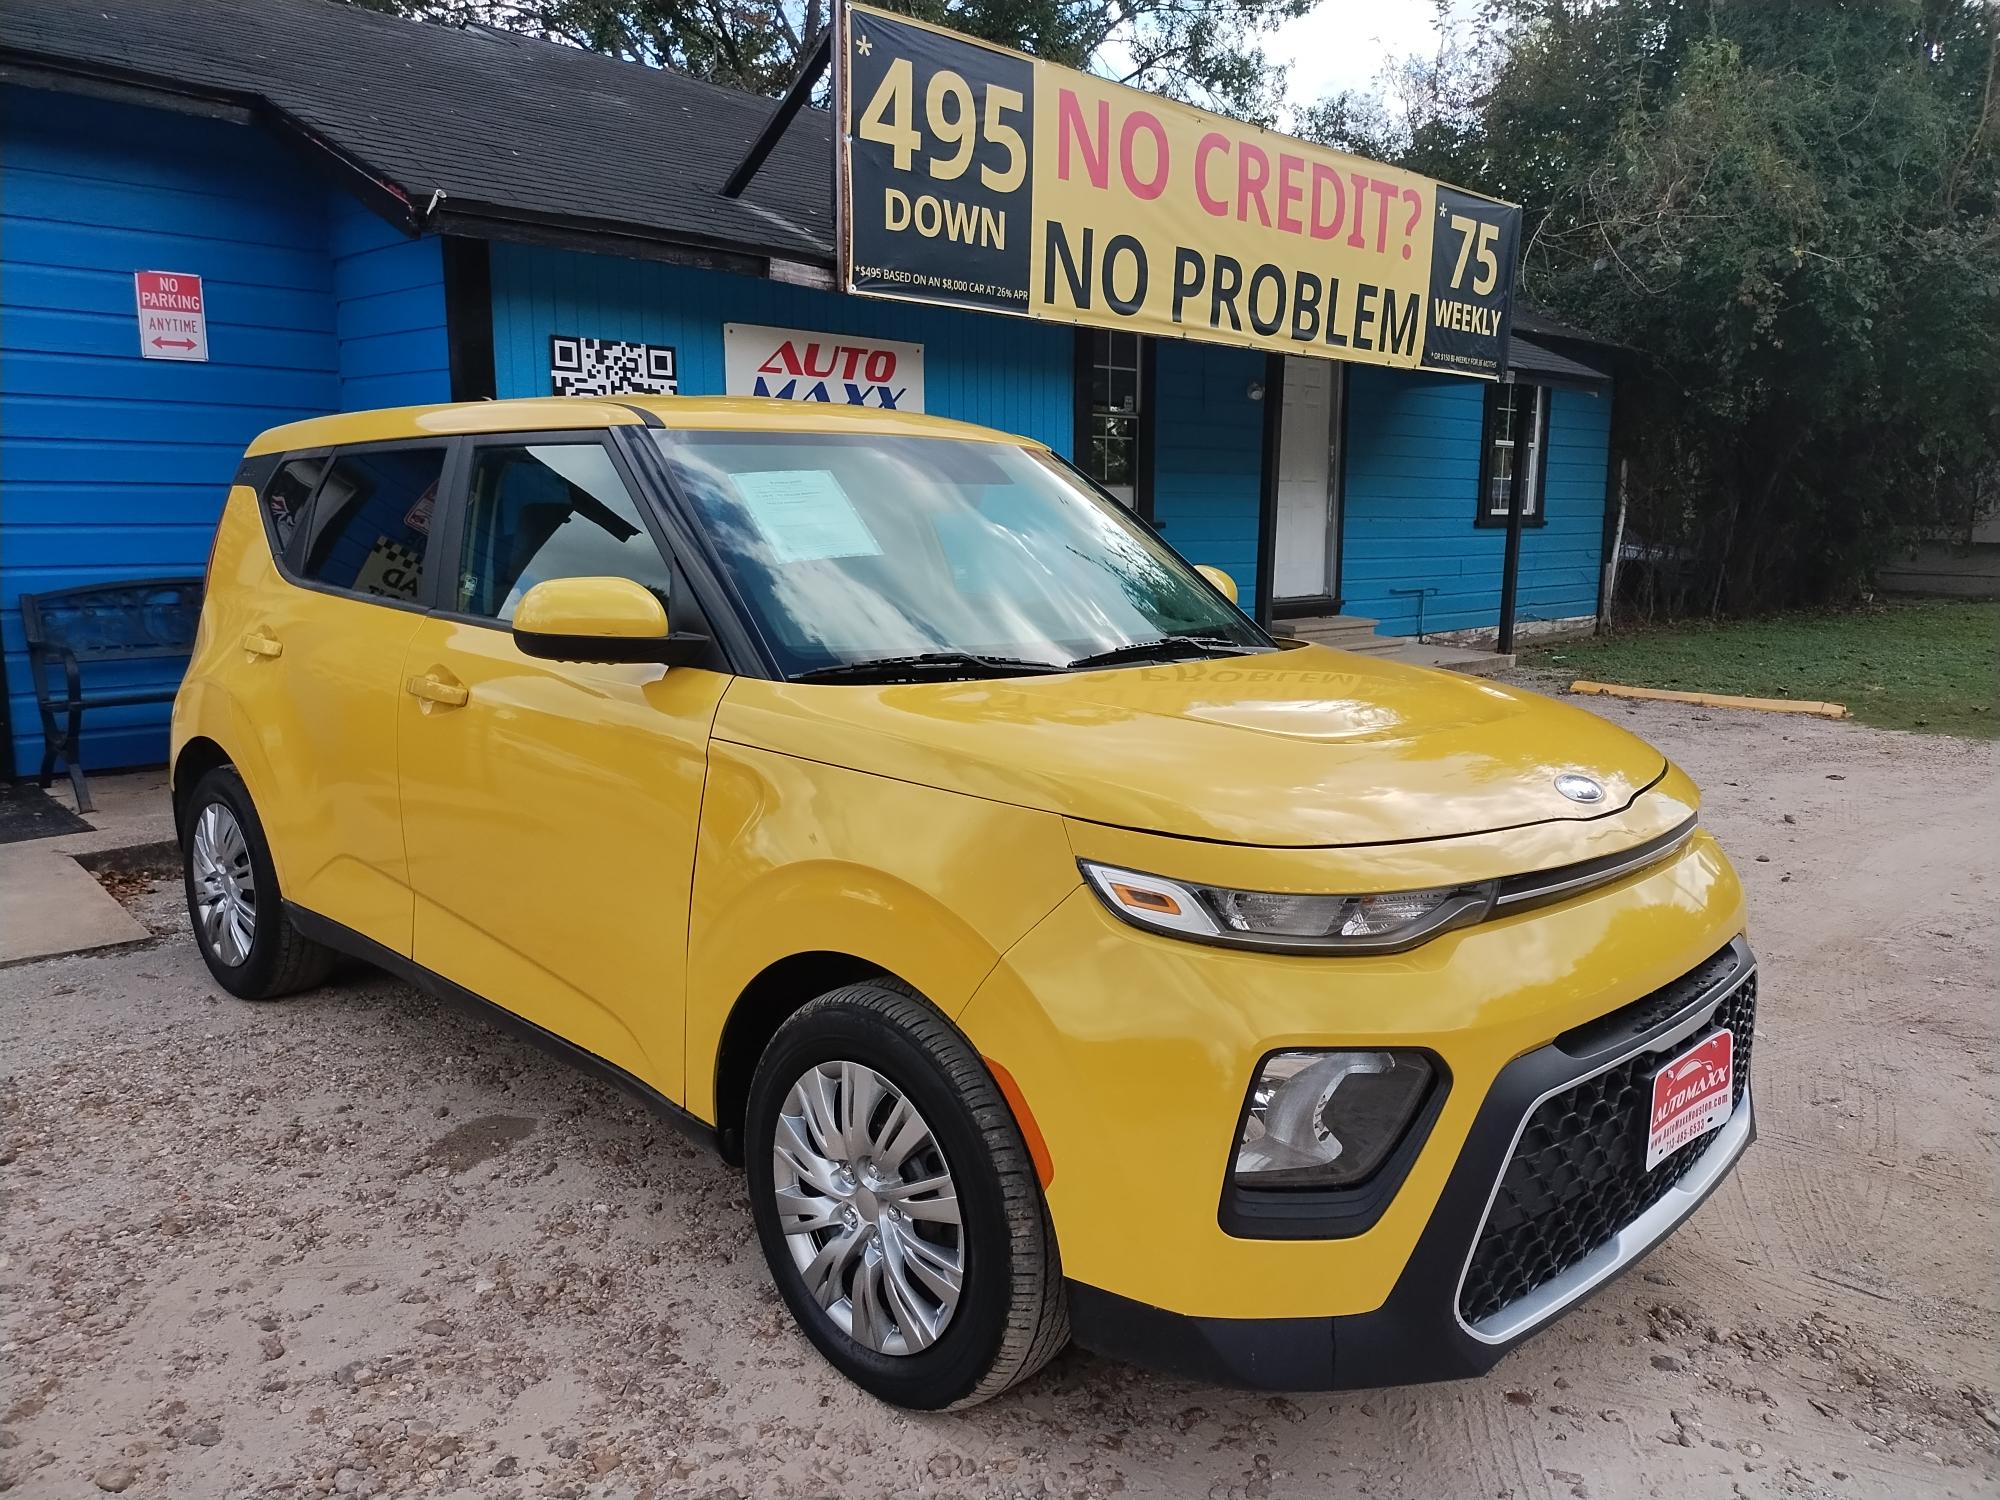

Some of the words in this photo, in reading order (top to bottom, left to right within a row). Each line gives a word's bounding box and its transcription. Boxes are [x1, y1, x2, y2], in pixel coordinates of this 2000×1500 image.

[1058, 87, 1169, 200] NO
[1195, 132, 1422, 261] CREDIT?
[885, 188, 1006, 250] DOWN
[142, 292, 200, 310] PARKING
[160, 277, 178, 292] NO
[883, 269, 911, 283] BASED
[913, 274, 927, 285] ON
[928, 276, 941, 287] AN
[942, 279, 968, 292] $8,000
[969, 283, 984, 294] CAR
[985, 285, 996, 295] AT
[997, 286, 1012, 298] 26%
[1013, 289, 1028, 300] APR
[1044, 219, 1149, 316] NO
[1172, 246, 1420, 356] PROBLEM
[149, 317, 198, 334] ANYTIME
[1435, 298, 1501, 337] WEEKLY
[757, 340, 897, 383] AUTO
[1652, 1065, 1728, 1127] AUTOMAXX
